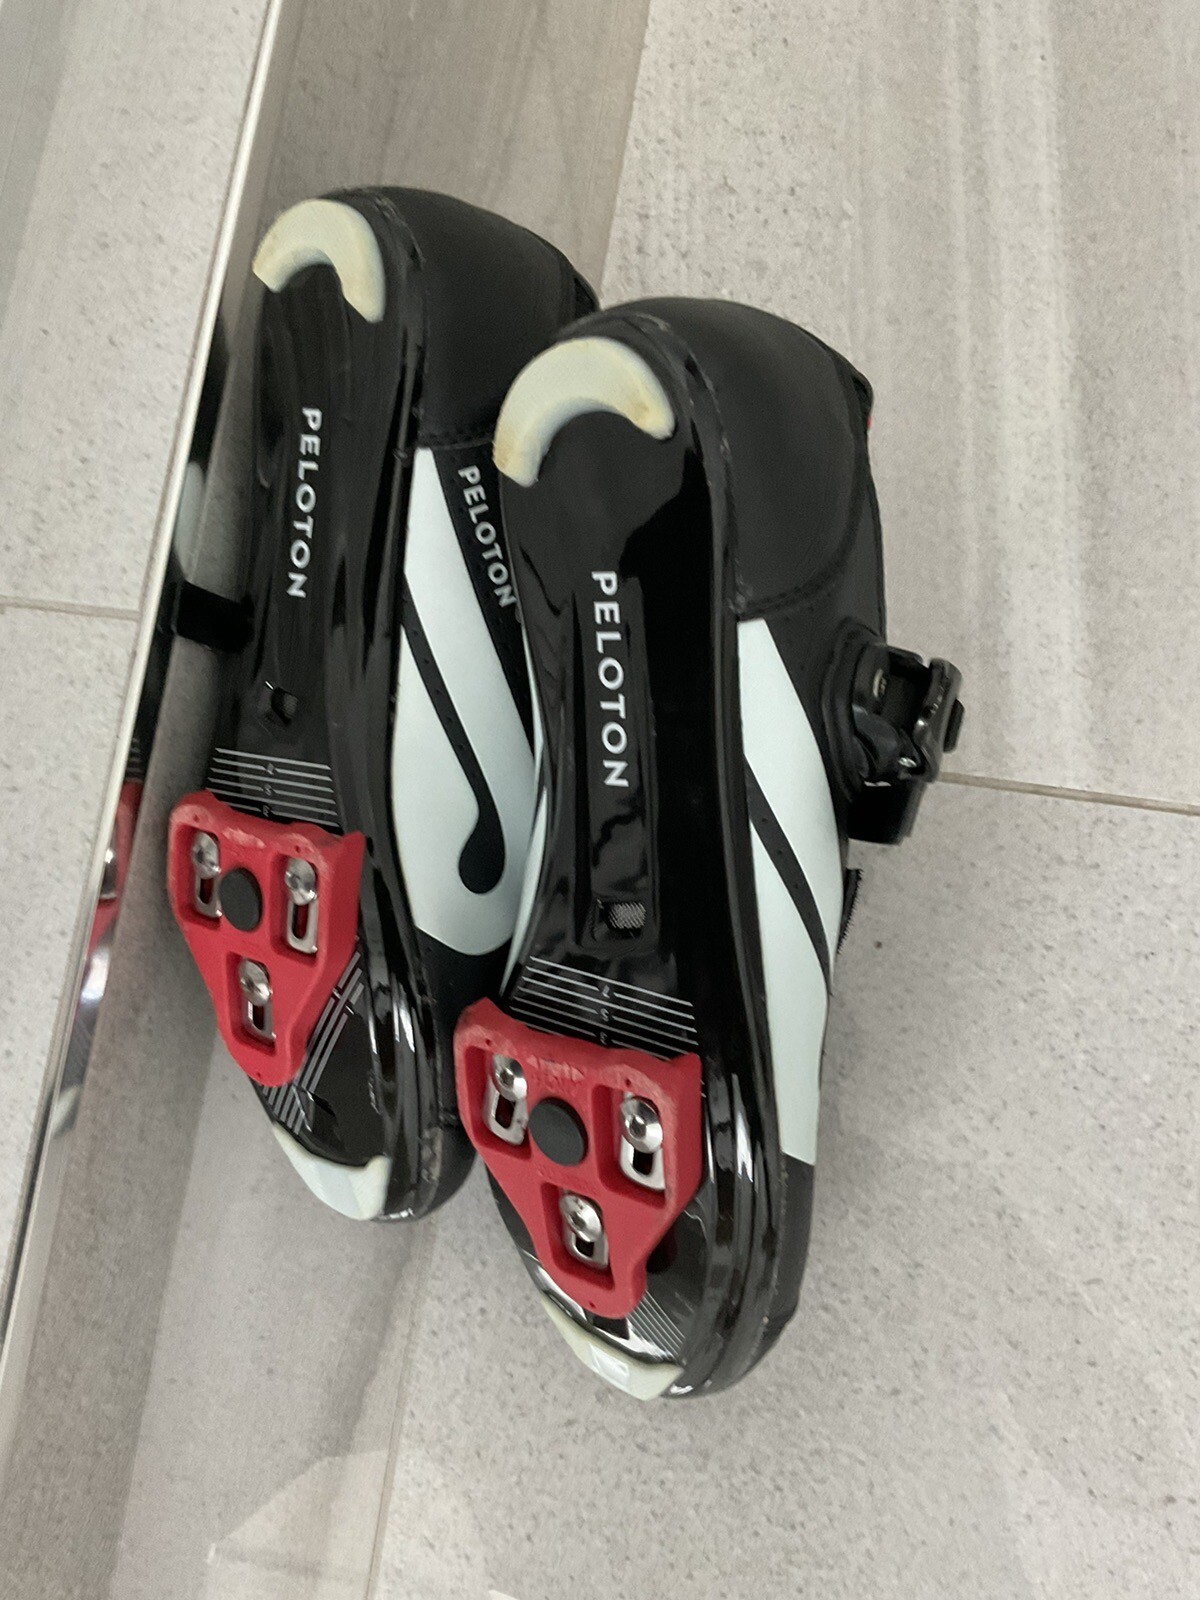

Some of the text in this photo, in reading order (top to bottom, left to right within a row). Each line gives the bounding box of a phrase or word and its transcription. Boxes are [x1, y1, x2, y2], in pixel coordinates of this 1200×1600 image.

[286, 407, 322, 598] PELOTON
[458, 465, 517, 608] PELOTON
[591, 570, 629, 788] PELOTON
